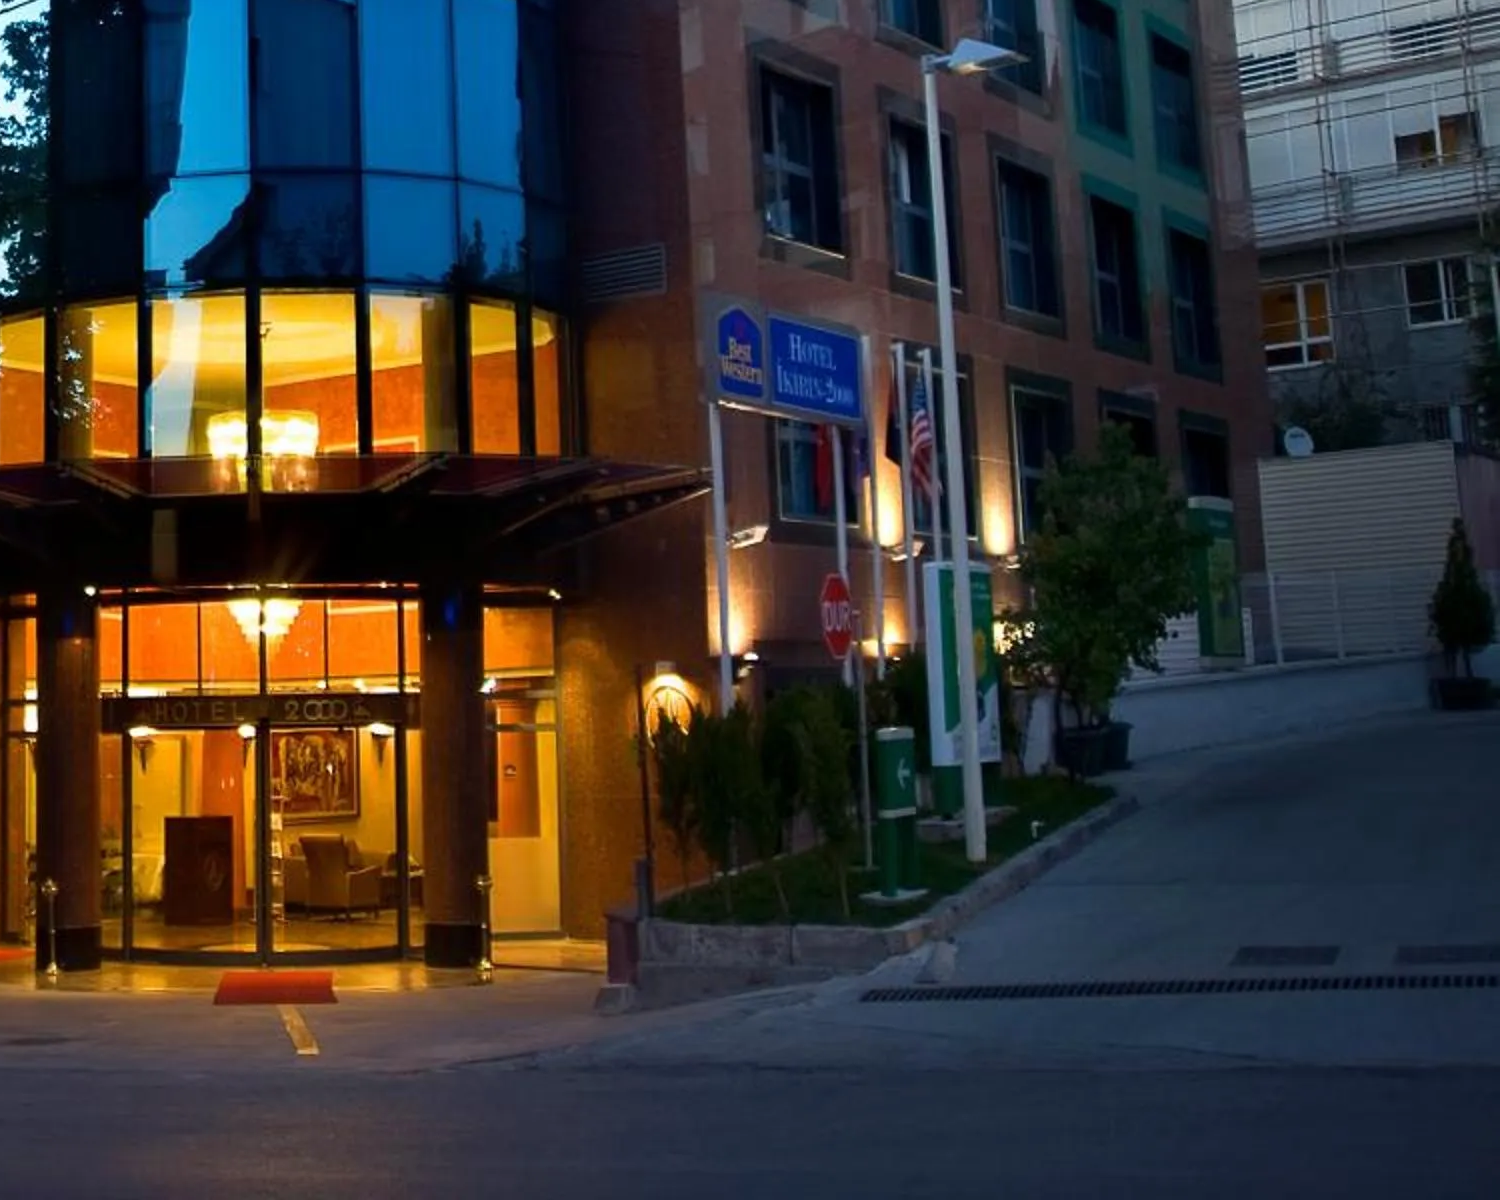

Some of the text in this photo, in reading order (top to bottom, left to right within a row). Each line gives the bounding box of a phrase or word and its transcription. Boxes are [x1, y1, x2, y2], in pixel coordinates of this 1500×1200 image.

[728, 336, 752, 365] Best
[788, 332, 837, 371] HOTEL
[721, 354, 763, 385] Western
[822, 601, 852, 631] DUR
[155, 700, 348, 722] HOTEL 2000
